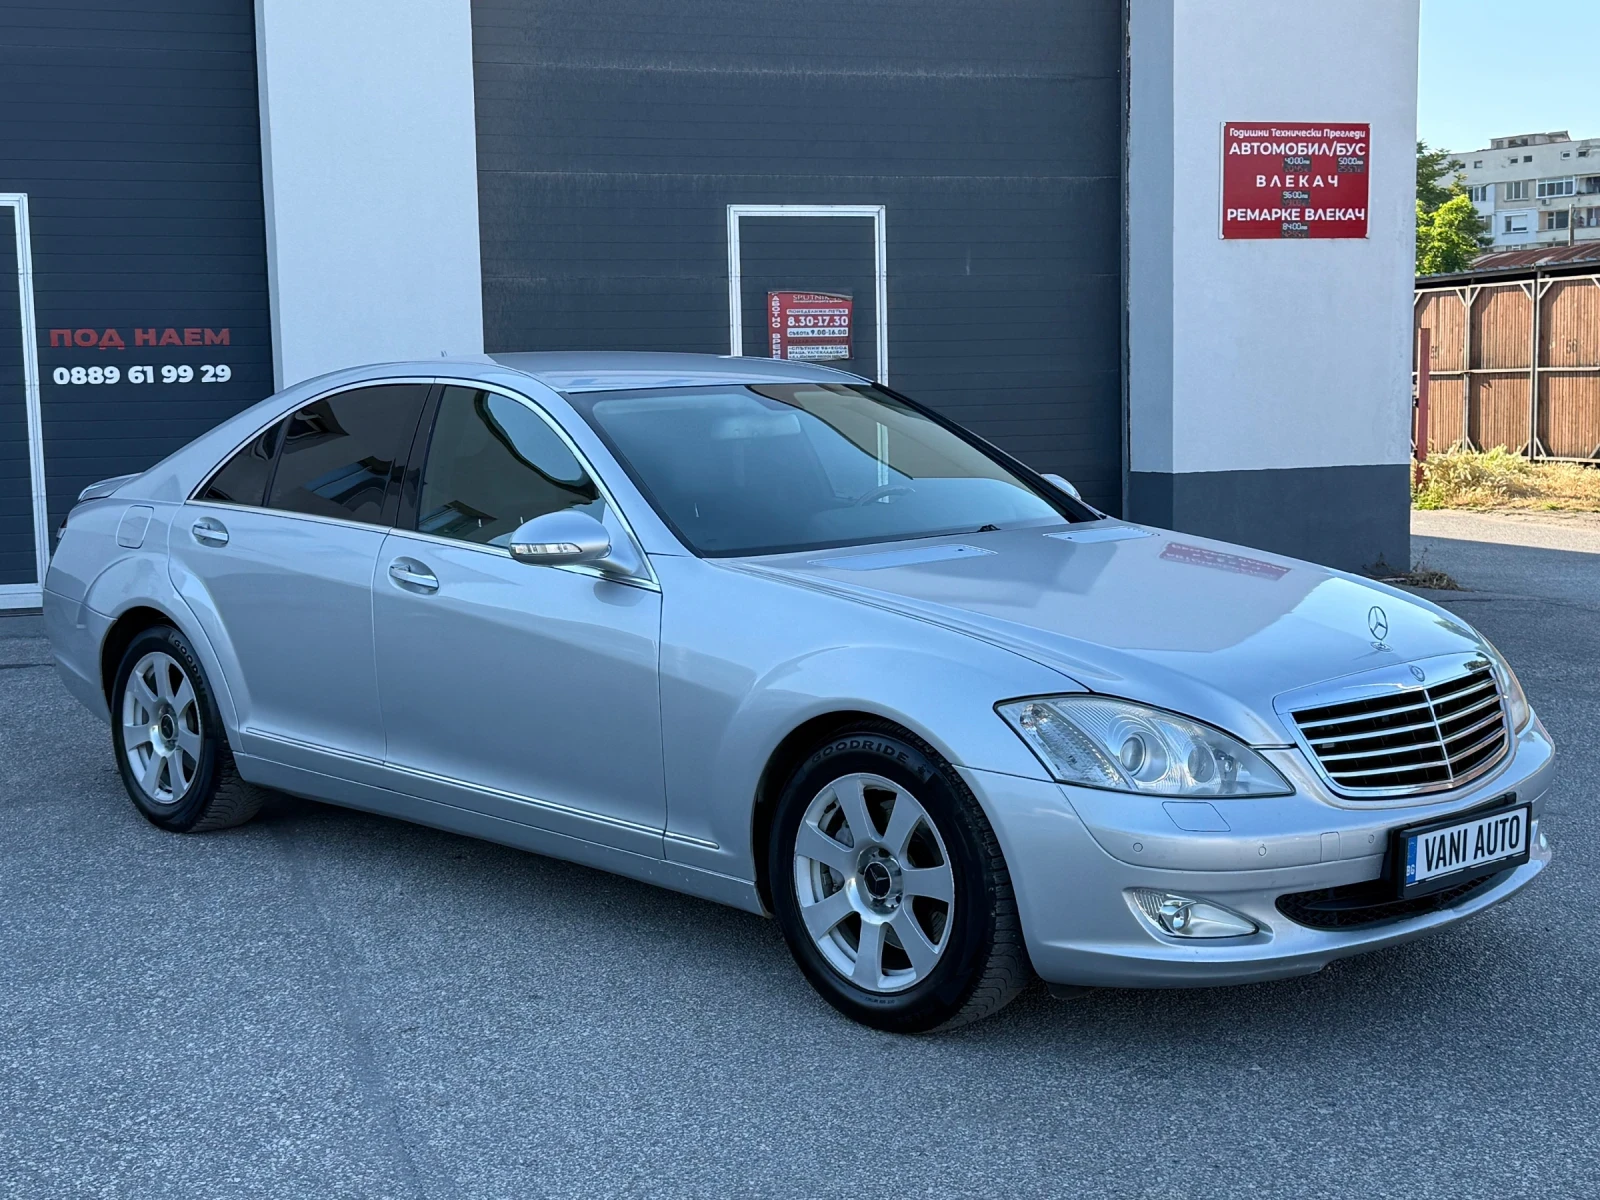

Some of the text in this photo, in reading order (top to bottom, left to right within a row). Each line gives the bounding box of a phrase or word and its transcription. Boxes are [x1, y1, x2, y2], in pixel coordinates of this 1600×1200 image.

[1229, 141, 1366, 157] АВТОМОБИЛ/БУС
[1256, 174, 1339, 188] ВЛЕКАЧ
[1227, 208, 1365, 221] РЕМАРКЕ ВЛЕКАЧ
[772, 293, 781, 328] АБОТНО
[787, 316, 848, 326] 8.30-17.30
[50, 327, 230, 350] ПОД НАЕМ
[53, 364, 232, 385] 0889 61 99 29
[812, 740, 909, 764] GOODRIDE
[1424, 814, 1520, 872] VANI AUTO
